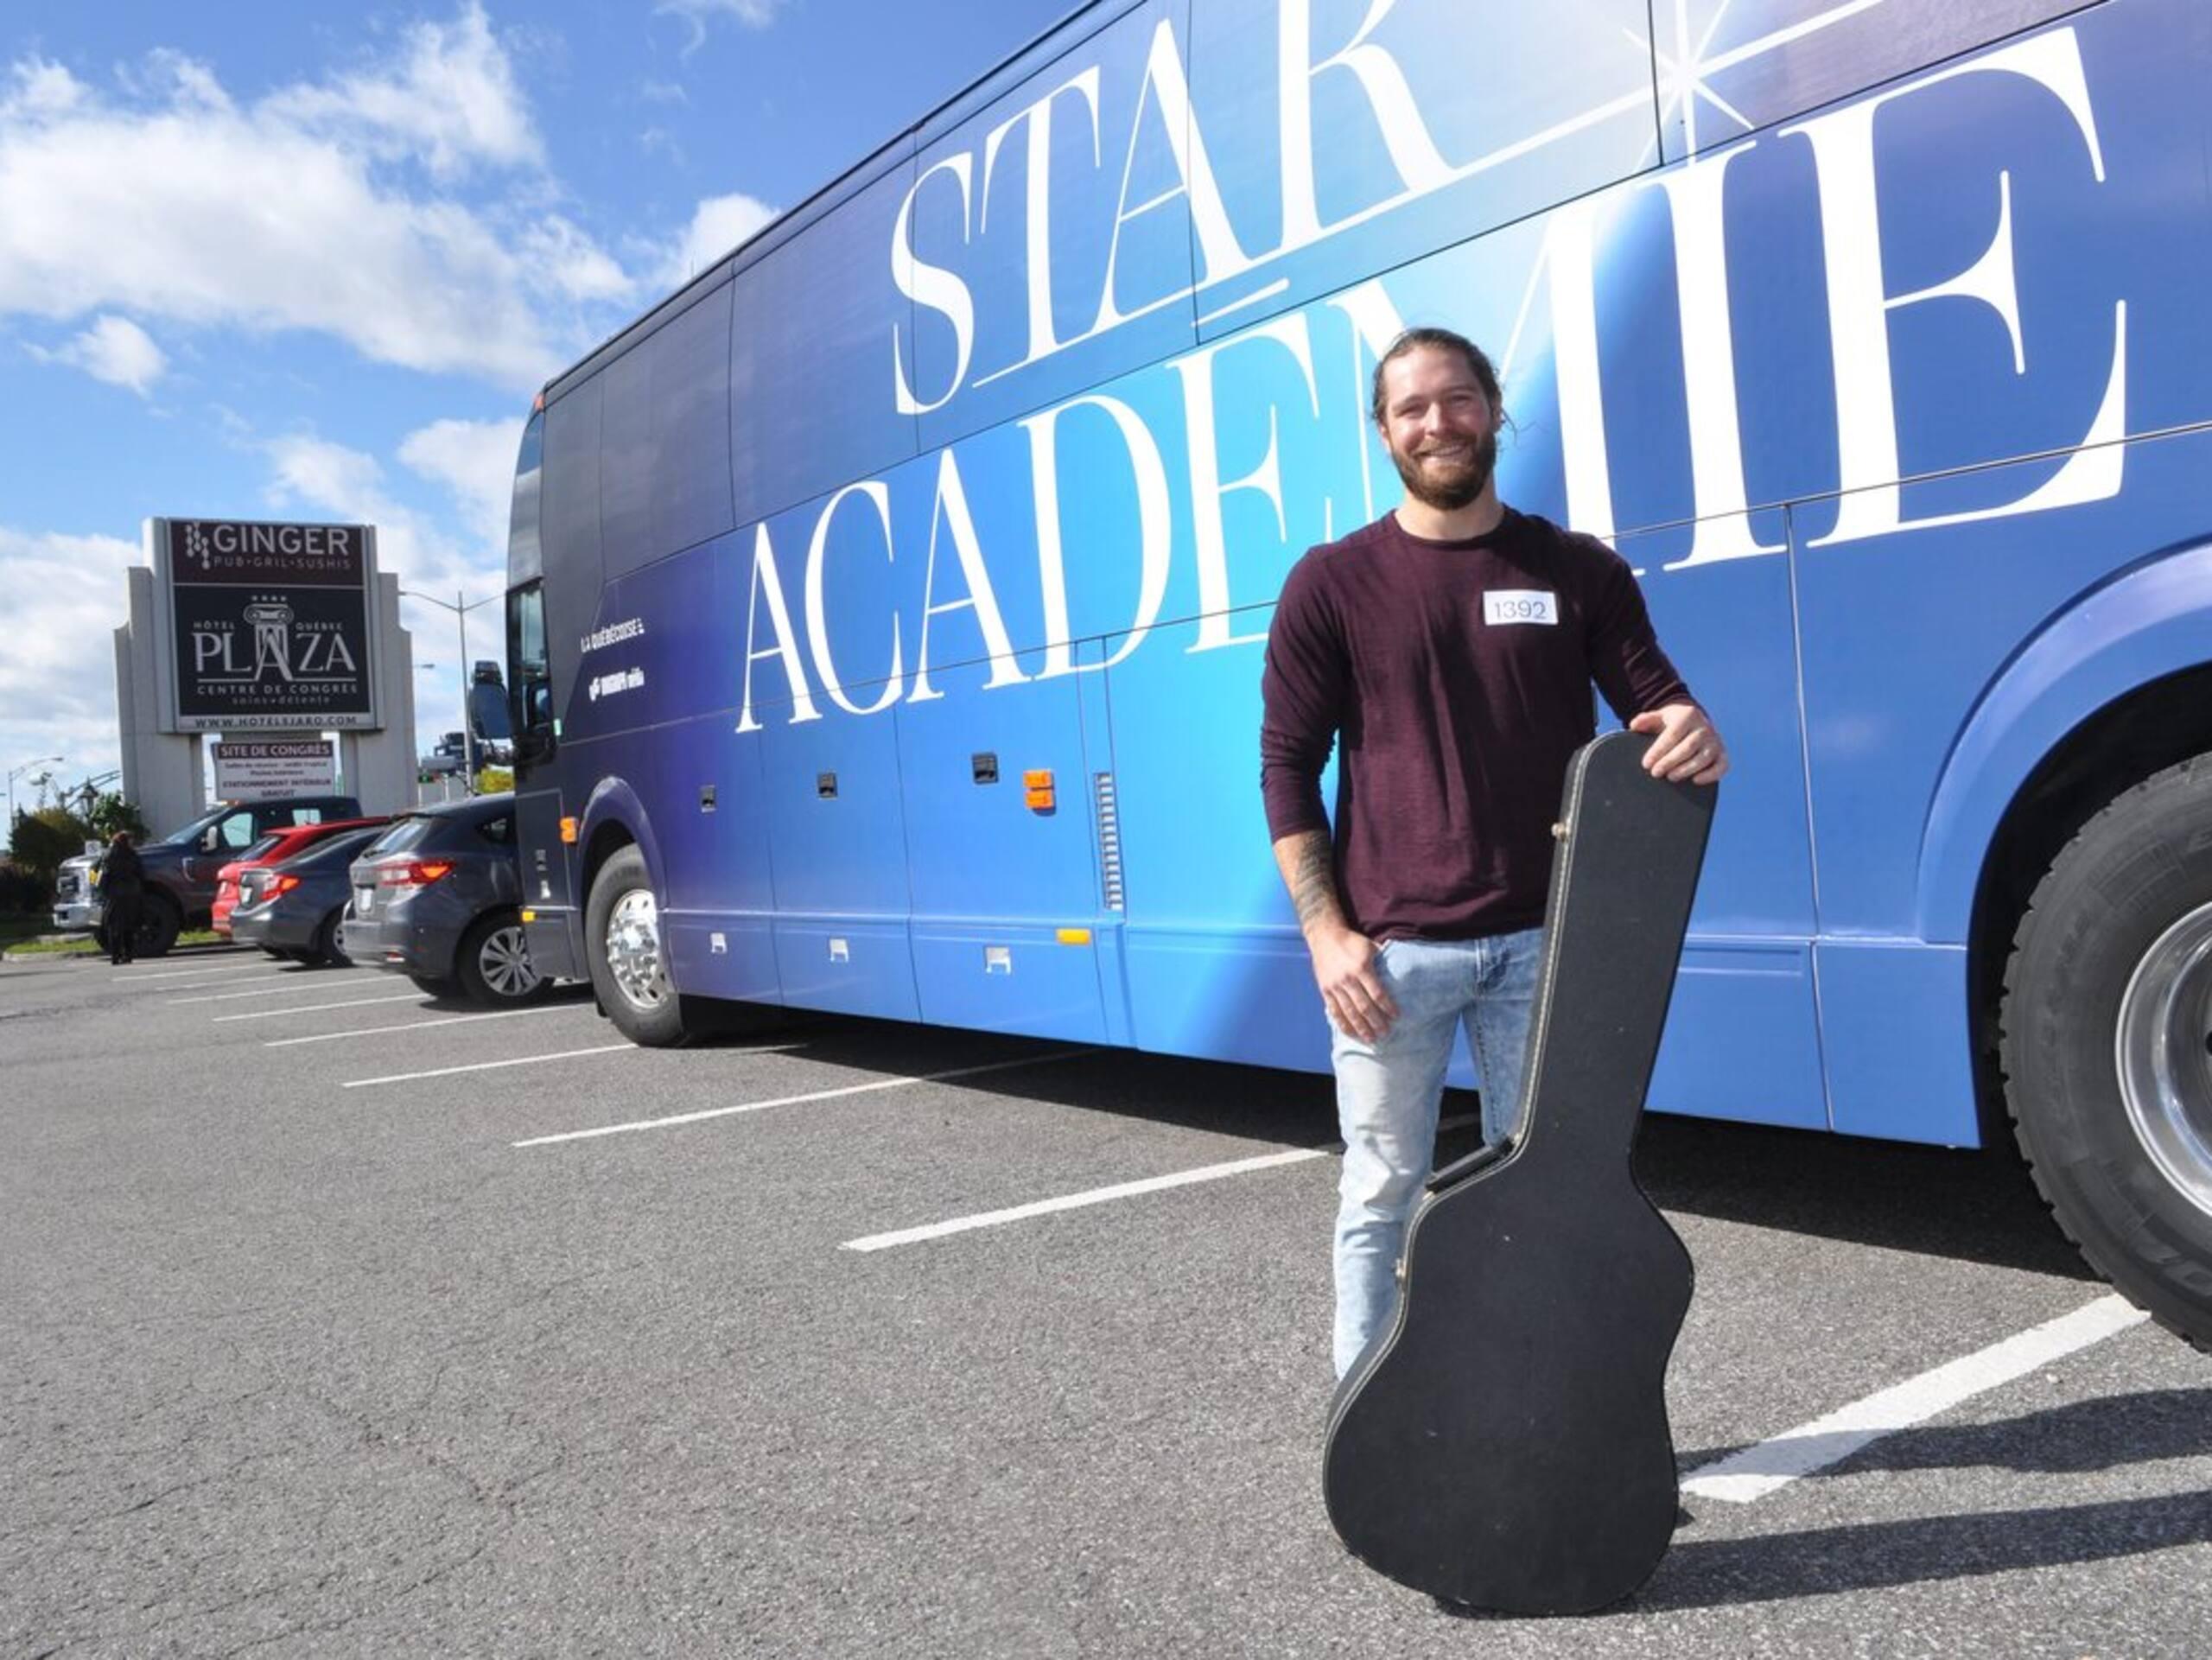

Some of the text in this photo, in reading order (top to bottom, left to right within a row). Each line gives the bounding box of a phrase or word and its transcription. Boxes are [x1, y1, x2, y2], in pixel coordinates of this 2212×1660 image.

[891, 0, 1462, 416] STAR
[213, 524, 350, 556] GINGER
[296, 557, 352, 570] SUSHIS
[1494, 600, 1548, 620] 1392
[193, 620, 344, 632] HÔTEL QUÉBEC
[192, 630, 357, 682] PLAZA
[197, 684, 256, 696] CENTRE
[263, 684, 283, 695] DE
[220, 743, 330, 757] SITE DE CONGRÈS
